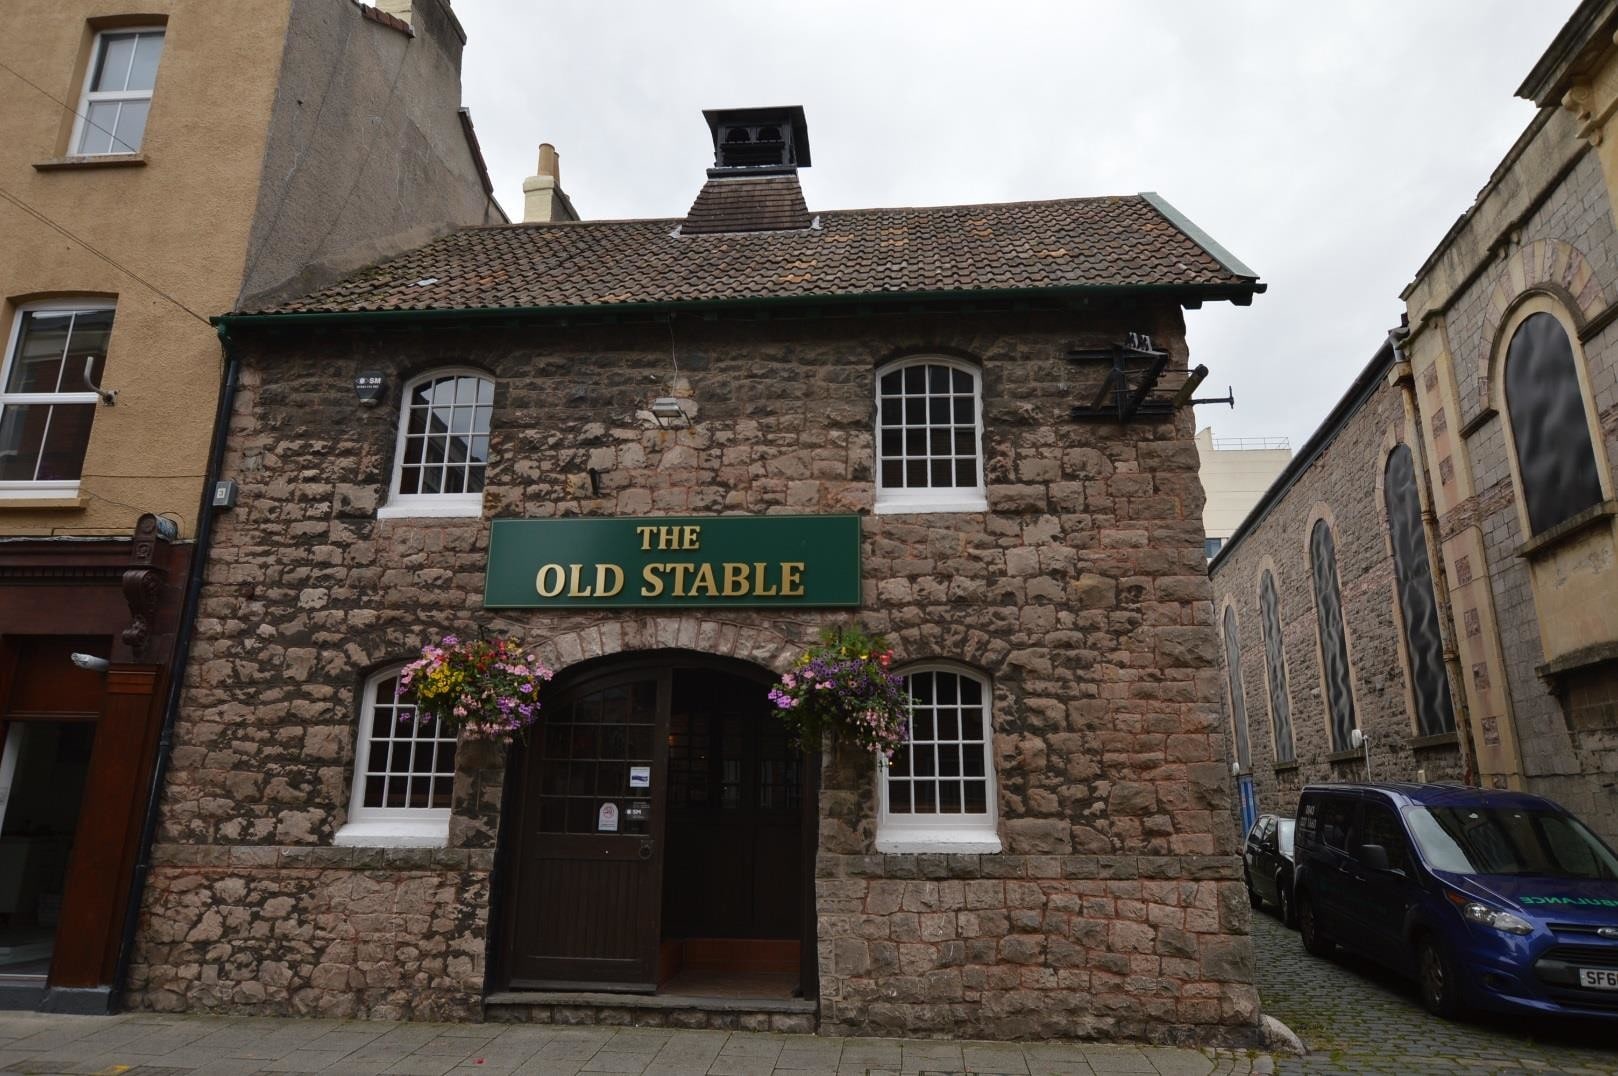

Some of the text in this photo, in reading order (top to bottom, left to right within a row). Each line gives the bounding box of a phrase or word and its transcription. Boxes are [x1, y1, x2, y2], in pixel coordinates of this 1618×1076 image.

[636, 525, 701, 551] THE
[535, 561, 806, 598] OLD STABLE
[1586, 971, 1618, 986] SF6
